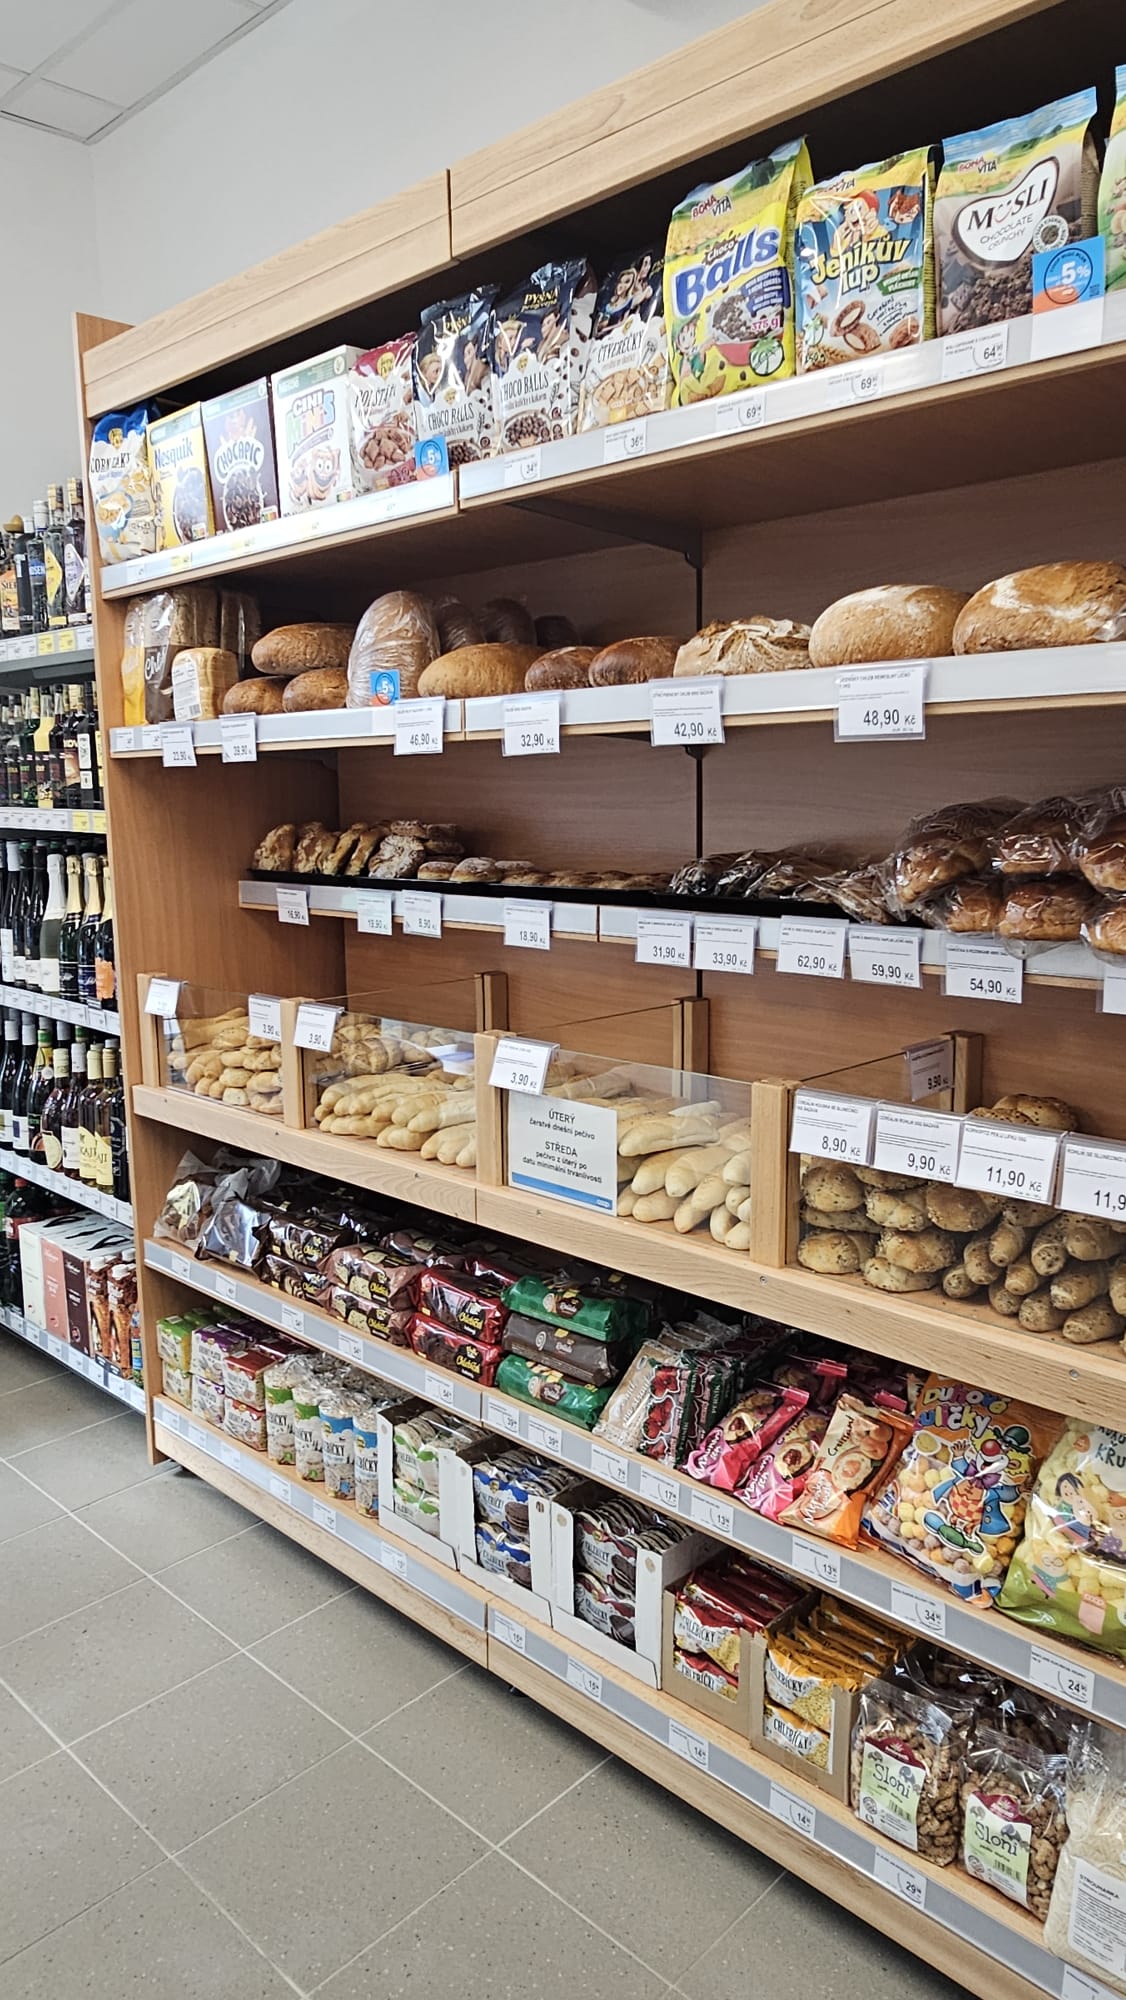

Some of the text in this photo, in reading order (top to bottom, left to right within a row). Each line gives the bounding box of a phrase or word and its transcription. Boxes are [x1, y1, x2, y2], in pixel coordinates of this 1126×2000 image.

[711, 195, 732, 217] VITA
[967, 177, 1049, 231] MÜSLI
[979, 213, 1034, 244] CHOCOLATE
[988, 227, 1026, 251] CRUNCHY
[810, 232, 913, 286] Jeníkův
[675, 227, 779, 317] Balls
[841, 263, 881, 297] lup
[983, 345, 996, 360] 64
[523, 371, 550, 394] BALLS
[860, 377, 872, 390] 69
[746, 406, 757, 418] 69
[154, 435, 195, 471] Nesquik
[216, 440, 262, 479] CHOCAPIC
[862, 708, 917, 728] 48,90 Kč
[409, 732, 431, 747] 46,90
[520, 732, 545, 748] 32,90
[673, 722, 718, 740] 42,90 Kč
[652, 945, 677, 960] 31,90
[712, 952, 738, 967] 33,90
[797, 954, 826, 971] 62,90
[871, 963, 915, 982] 59,90 Kč
[969, 977, 1017, 996] 54,90 Kč
[510, 1071, 530, 1087] 3,90
[548, 1107, 576, 1125] ÚTERÝ
[574, 1127, 596, 1141] pečivo
[544, 1140, 578, 1158] STŘEDA
[821, 1135, 861, 1157] 8,90 Kč
[522, 1155, 536, 1166] datu
[535, 1150, 556, 1164] pečivo
[561, 1156, 578, 1170] úterý
[578, 1162, 588, 1170] po
[906, 1152, 952, 1176] 9,90 Kč
[986, 1165, 1042, 1192] 11,90 Kč
[717, 1514, 727, 1524] 13
[823, 1562, 833, 1574] 13
[924, 1609, 935, 1621] 34
[1068, 1679, 1081, 1693] 24
[872, 1762, 911, 1800] Sloni
[974, 1820, 1018, 1857] Sloni
[905, 1880, 917, 1894] 29
